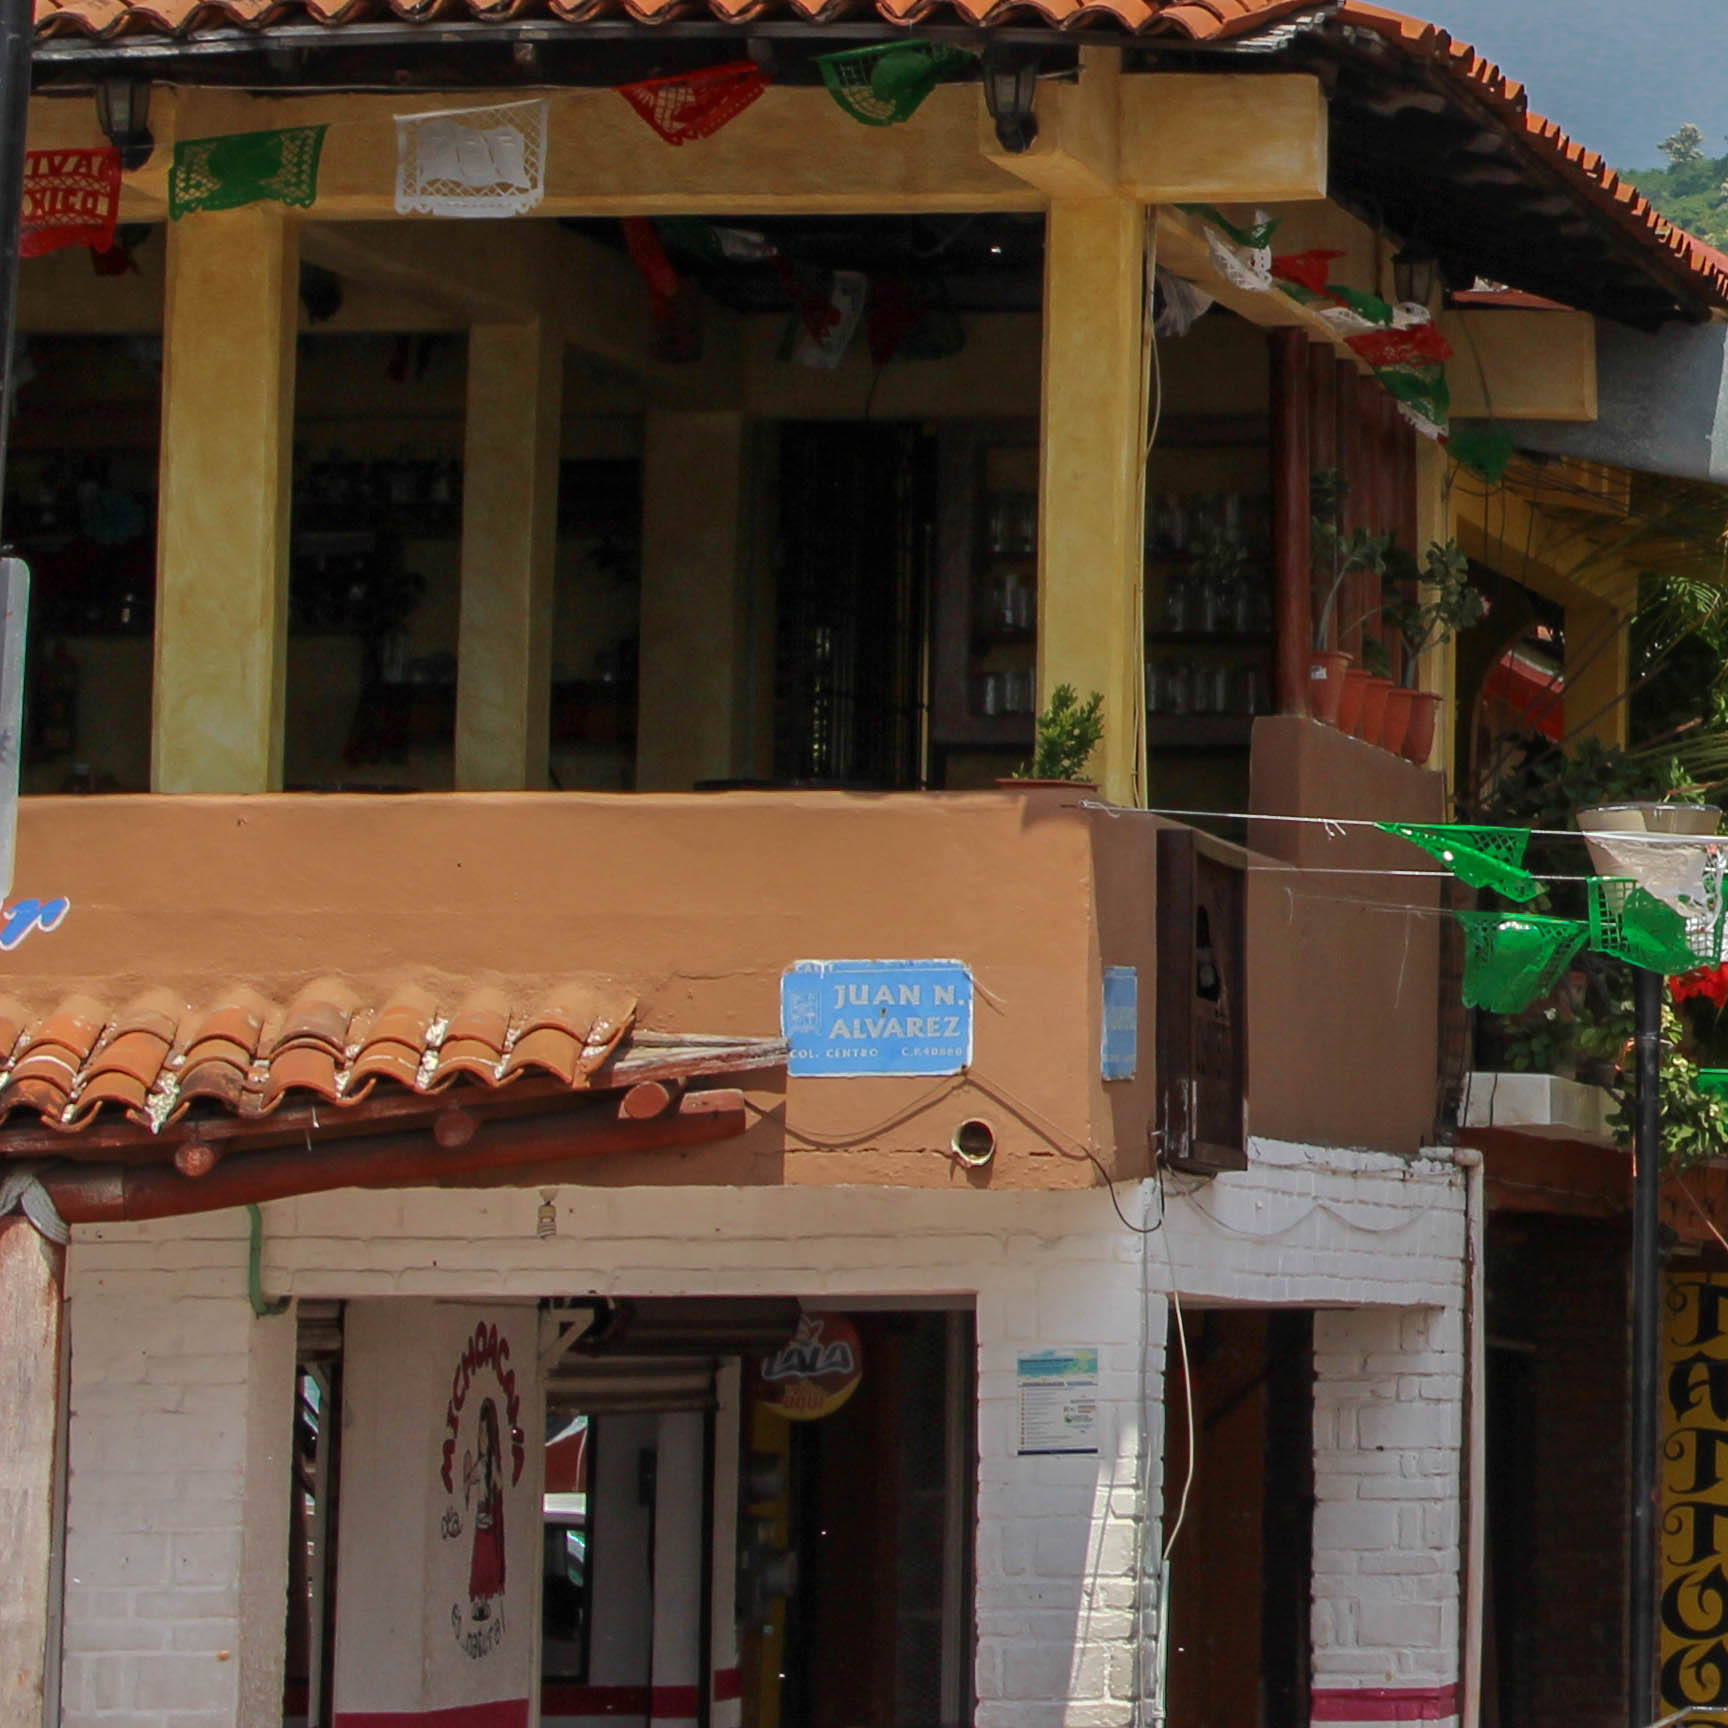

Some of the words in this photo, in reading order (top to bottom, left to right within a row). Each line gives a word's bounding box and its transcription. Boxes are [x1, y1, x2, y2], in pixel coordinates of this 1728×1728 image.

[24, 157, 98, 176] IVA
[834, 984, 920, 1009] JUAN
[934, 984, 965, 1006] N.
[829, 1016, 961, 1039] ALVAREZ
[826, 1048, 878, 1058] CENTRO
